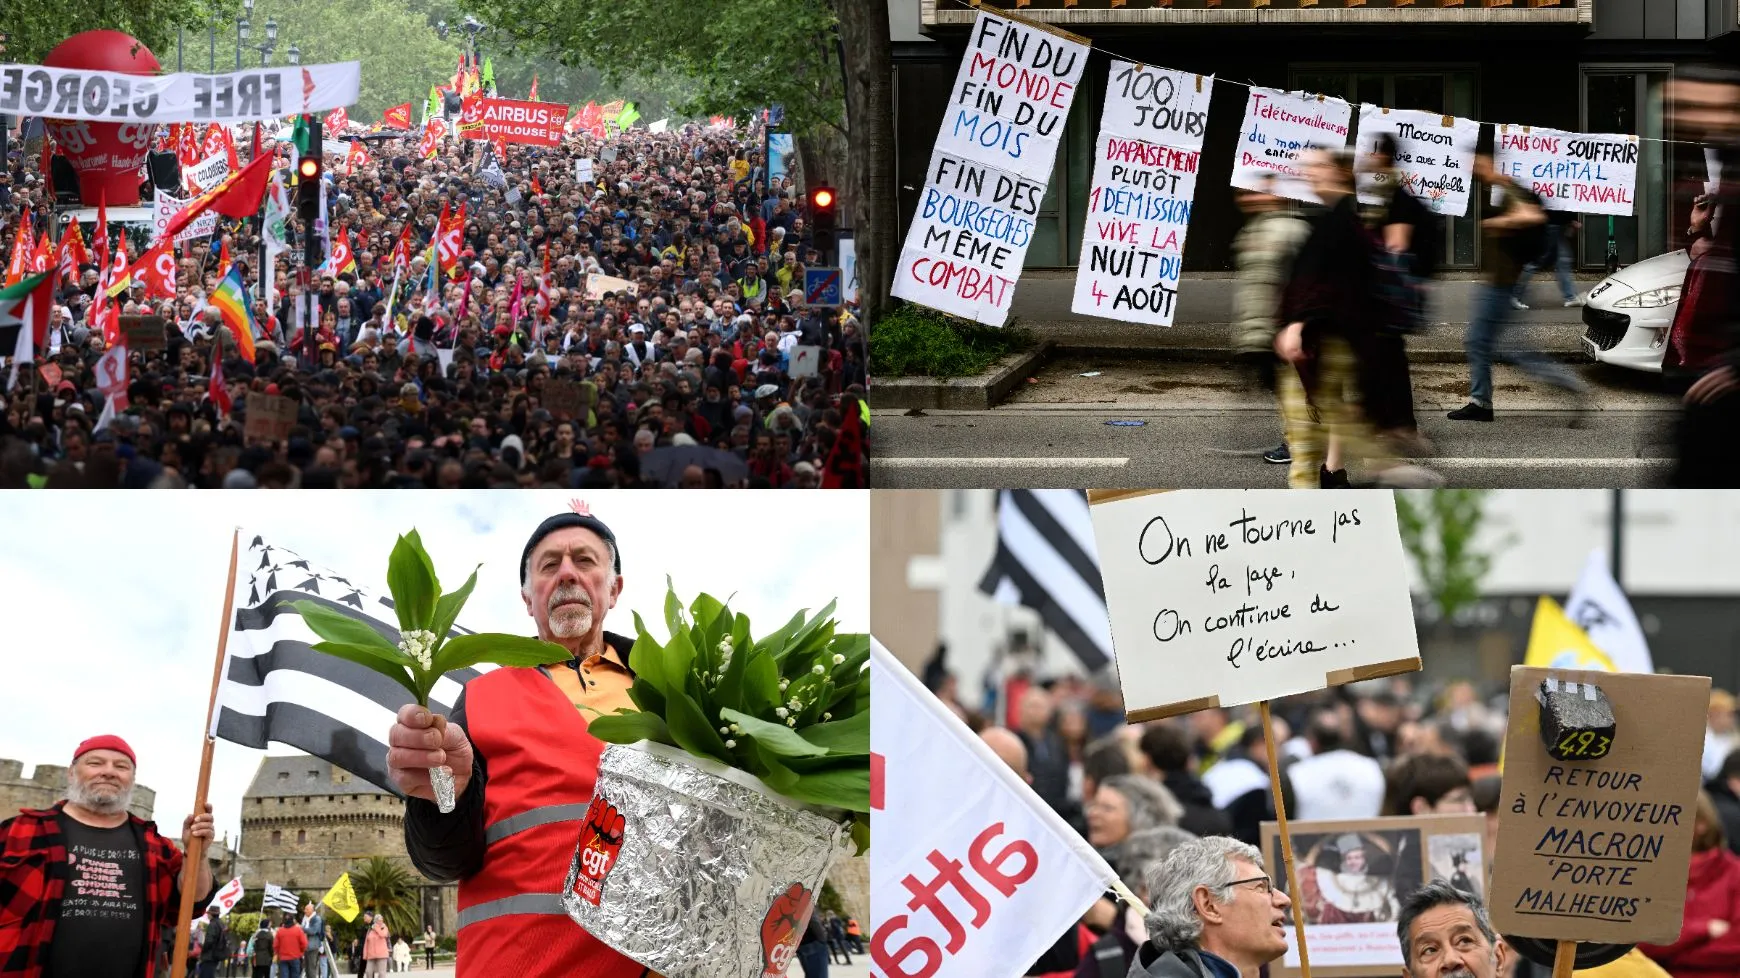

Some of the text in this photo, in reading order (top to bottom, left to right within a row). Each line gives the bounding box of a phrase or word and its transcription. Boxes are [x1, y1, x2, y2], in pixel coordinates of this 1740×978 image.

[977, 17, 1076, 78] FIN DU
[970, 52, 1073, 109] MONDE
[1116, 68, 1174, 106] 100
[484, 105, 548, 124] AIRBUS
[959, 82, 1059, 136] FIN DU
[1134, 105, 1206, 138] JOURS
[954, 110, 1029, 159] MOIS
[1248, 123, 1266, 145] du
[1396, 122, 1453, 146] Macron
[1107, 138, 1200, 174] D'APAISEMENT
[1416, 155, 1436, 166] avec
[1443, 154, 1460, 169] toi
[1566, 139, 1638, 164] SOUFFRIR
[936, 158, 1041, 215] FIN DES
[1111, 165, 1181, 194] PLUTÔT
[1419, 174, 1466, 195] poubelle
[1501, 159, 1608, 181] LE CAPITAL
[1091, 186, 1193, 225] 1 DÉMISSION
[1532, 182, 1632, 204] PAS LE TRAVAIL
[924, 225, 1012, 270] MÊME
[1098, 220, 1178, 250] VIVE LA
[1091, 245, 1180, 281] NUIT DU
[912, 257, 1014, 307] COMBAT
[1092, 281, 1177, 318] 4 AOÛT
[1139, 507, 1361, 565] On ne tourne pas
[1206, 564, 1232, 594] la
[1153, 594, 1339, 642] On continue de
[1559, 731, 1611, 757] 49.3
[1544, 766, 1643, 792] RETOUR
[1511, 792, 1683, 826] à l'ENVOYEUR
[1535, 827, 1664, 859] MACRON
[582, 847, 610, 876] cgt
